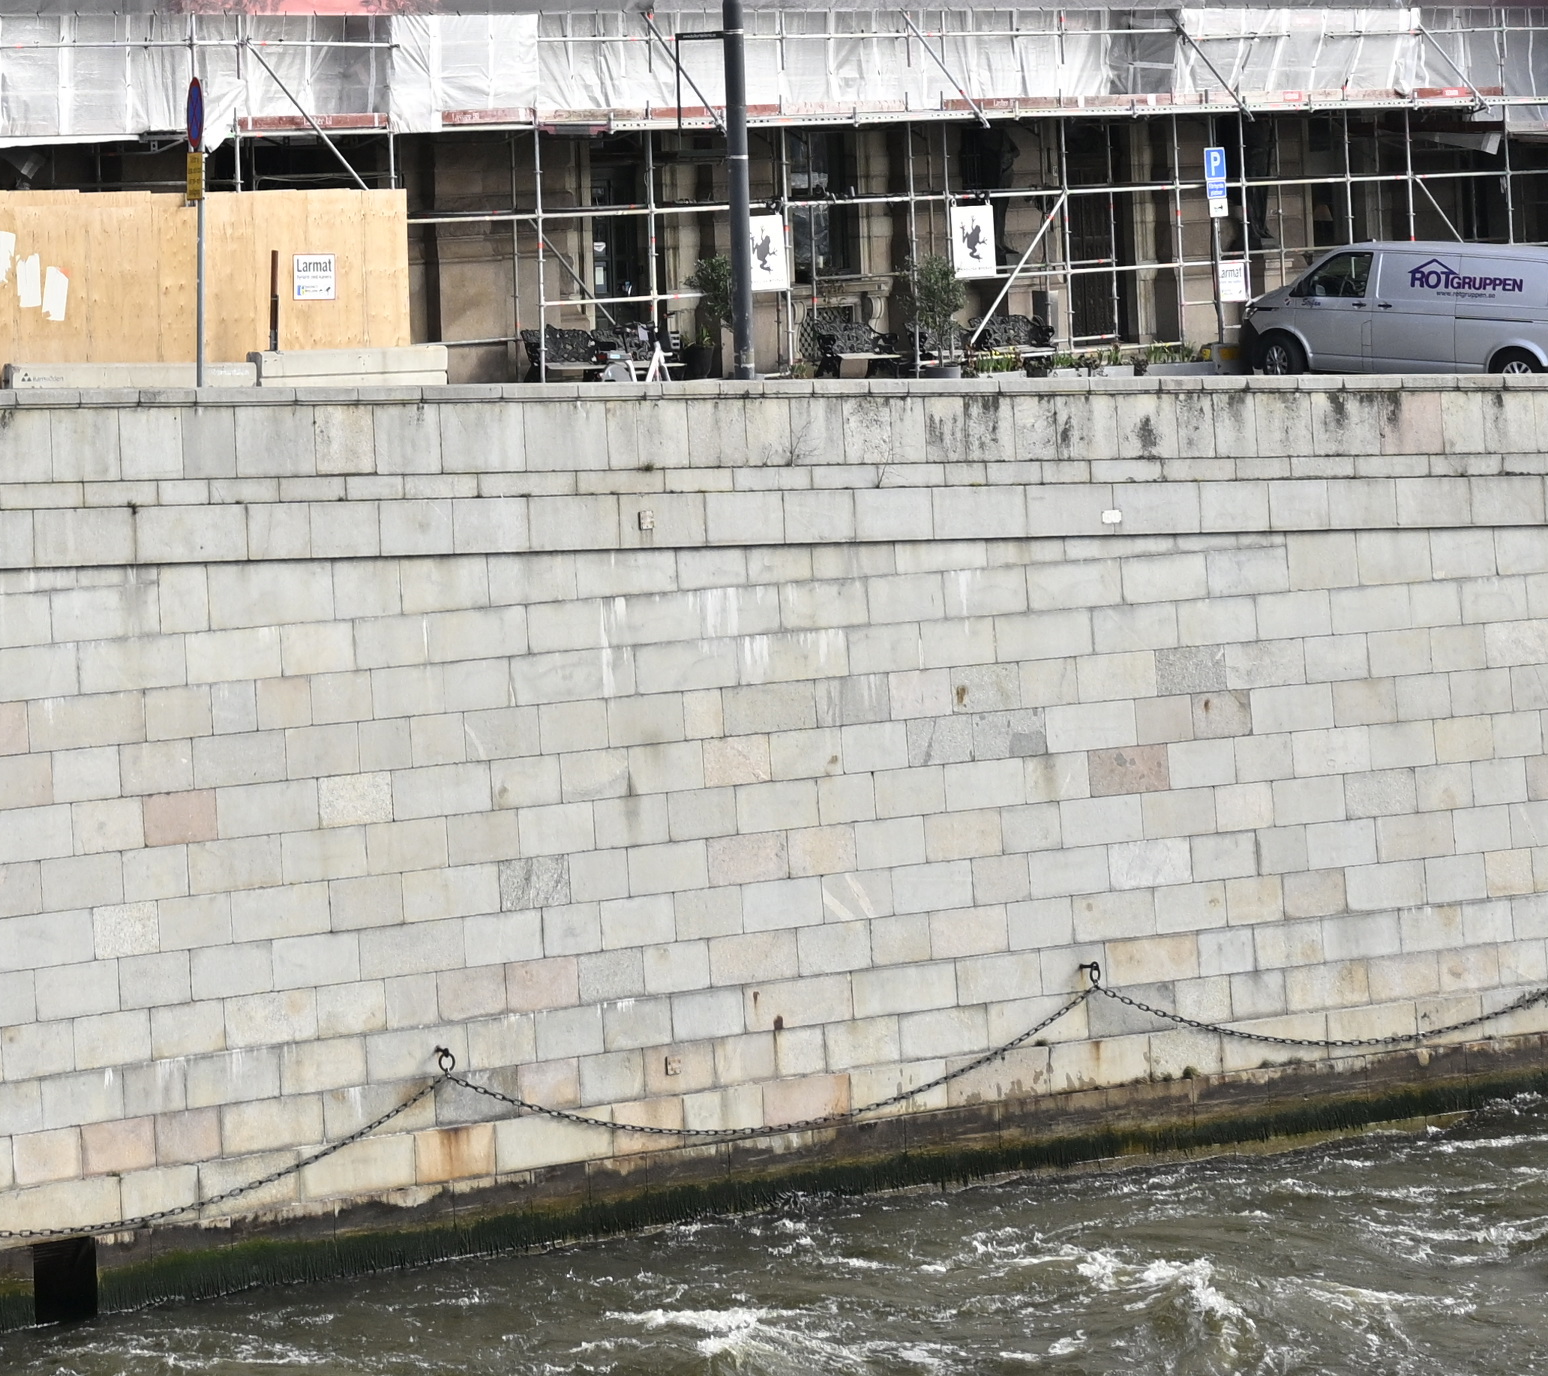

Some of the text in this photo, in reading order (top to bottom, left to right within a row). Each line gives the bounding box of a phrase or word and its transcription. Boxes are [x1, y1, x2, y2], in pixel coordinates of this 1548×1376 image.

[1210, 151, 1221, 177] P
[296, 258, 332, 273] Larmat
[1219, 266, 1243, 280] armat
[1410, 270, 1523, 292] ROTGRUPPEN
[1436, 291, 1496, 299] www.rotgruppen.se
